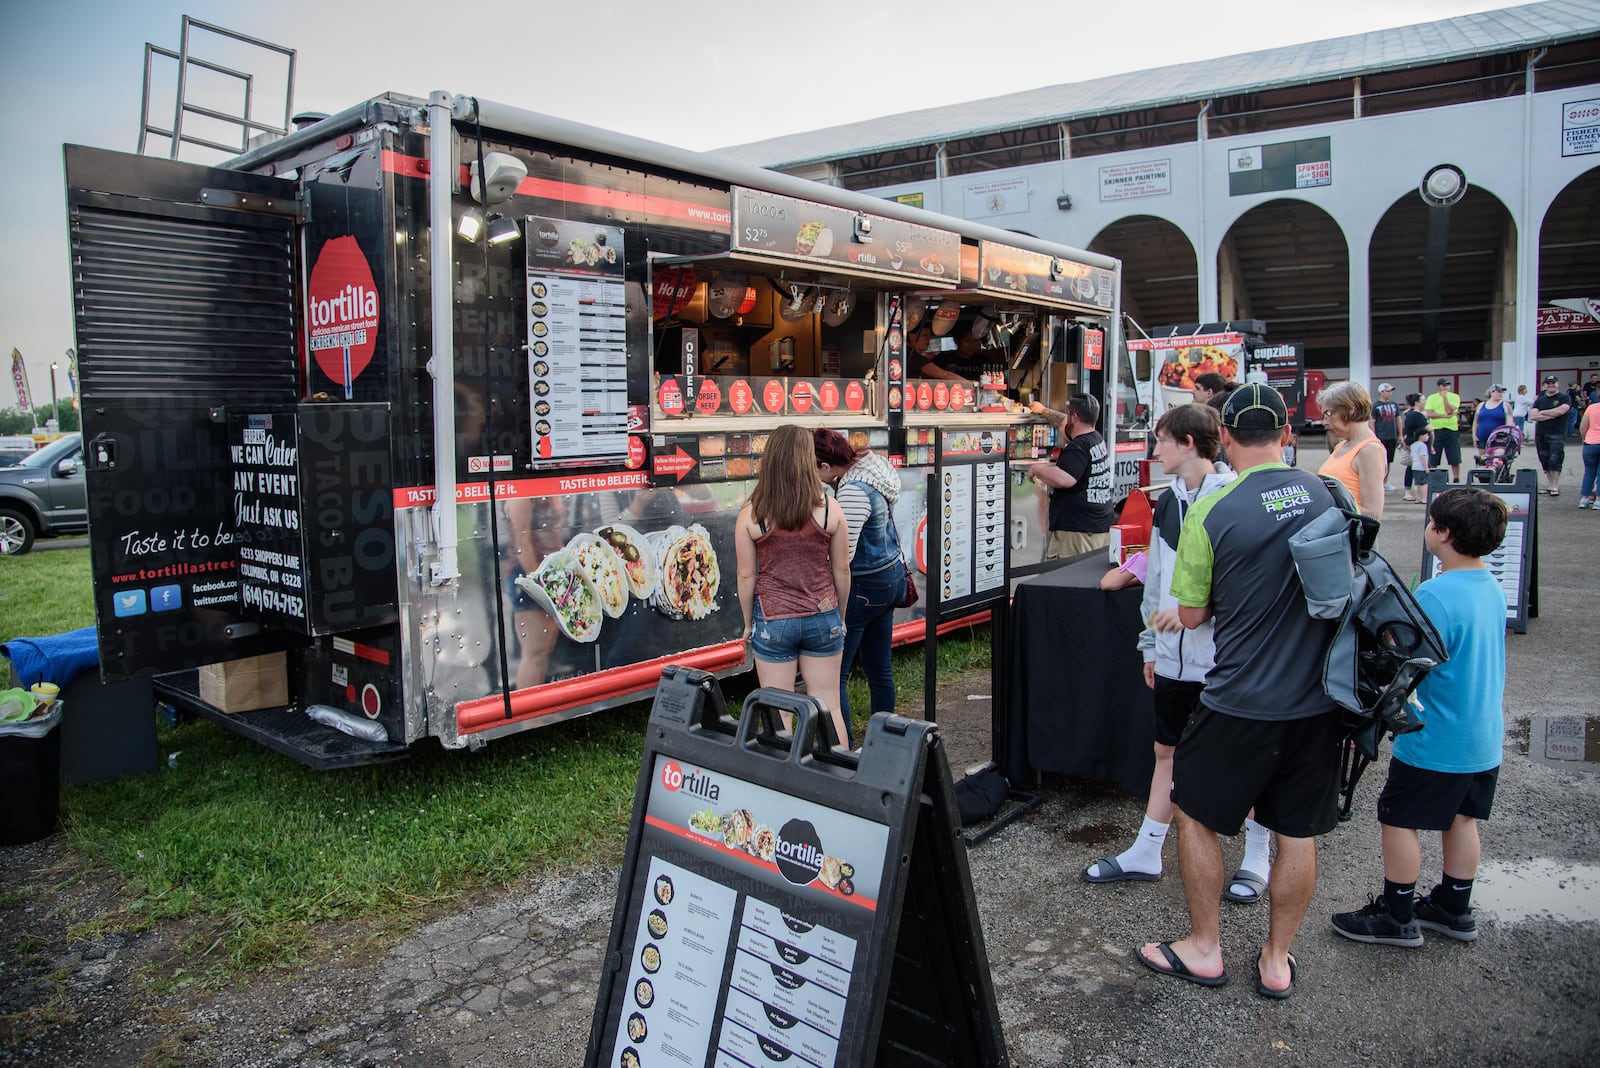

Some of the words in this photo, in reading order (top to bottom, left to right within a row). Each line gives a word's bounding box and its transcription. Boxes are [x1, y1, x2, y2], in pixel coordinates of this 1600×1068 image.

[1570, 108, 1599, 119] OHIO
[1298, 162, 1329, 173] SPONSOR
[1311, 171, 1329, 179] SIGN
[1104, 176, 1133, 185] SKINNER
[1135, 171, 1167, 181] PAINTING
[658, 283, 689, 298] Hoa!
[310, 284, 377, 327] tortilla
[312, 328, 331, 337] delicious
[331, 325, 350, 335] mexican
[350, 321, 364, 331] street
[365, 319, 377, 328] food
[310, 334, 339, 350] EMERGENCY
[340, 331, 354, 347] SHUT
[355, 330, 367, 344] OFF
[1254, 344, 1296, 360] cupzilla
[685, 342, 694, 398] ORDER
[231, 445, 244, 464] WE
[245, 445, 264, 465] CAN
[265, 434, 298, 466] Cater
[234, 471, 254, 492] ANY
[258, 473, 297, 496] EVENT
[507, 484, 517, 494] it.
[559, 478, 588, 491] TASTE
[588, 476, 596, 488] it
[596, 476, 606, 487] to
[607, 473, 640, 487] BELIEVE
[1260, 484, 1307, 502] PICKLEBALL
[234, 491, 261, 527] Just
[263, 506, 283, 528] ASK
[284, 509, 299, 530] US
[1265, 495, 1311, 513] ROCKS
[121, 530, 167, 555] Taste
[172, 528, 185, 550] it
[190, 527, 210, 548] to
[240, 547, 254, 560] 4233
[254, 548, 283, 566] SHOPPERS
[284, 554, 300, 570] LANE
[241, 563, 270, 585] COLUMBUS,
[269, 569, 280, 583] OH
[664, 764, 720, 801] tortilla
[775, 835, 824, 868] tortilla
